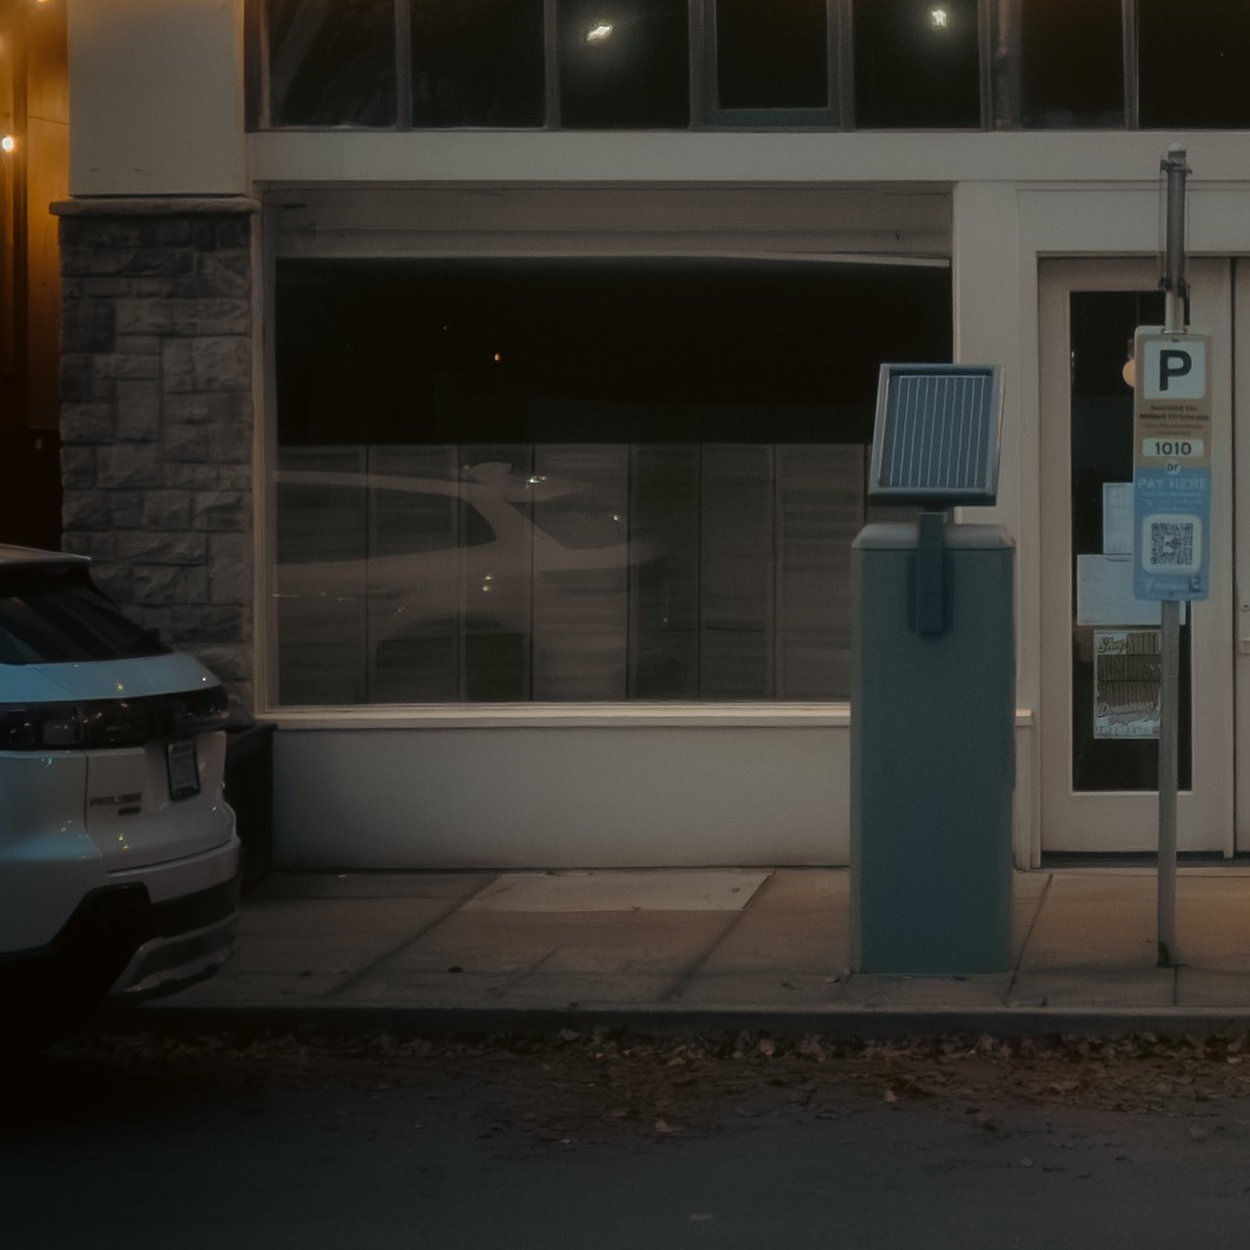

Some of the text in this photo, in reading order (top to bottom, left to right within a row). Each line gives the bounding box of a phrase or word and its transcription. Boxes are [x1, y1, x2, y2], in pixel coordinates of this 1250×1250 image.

[1159, 350, 1192, 391] P
[1155, 442, 1192, 455] 1010
[1167, 463, 1179, 471] or
[1137, 478, 1165, 489] PAY
